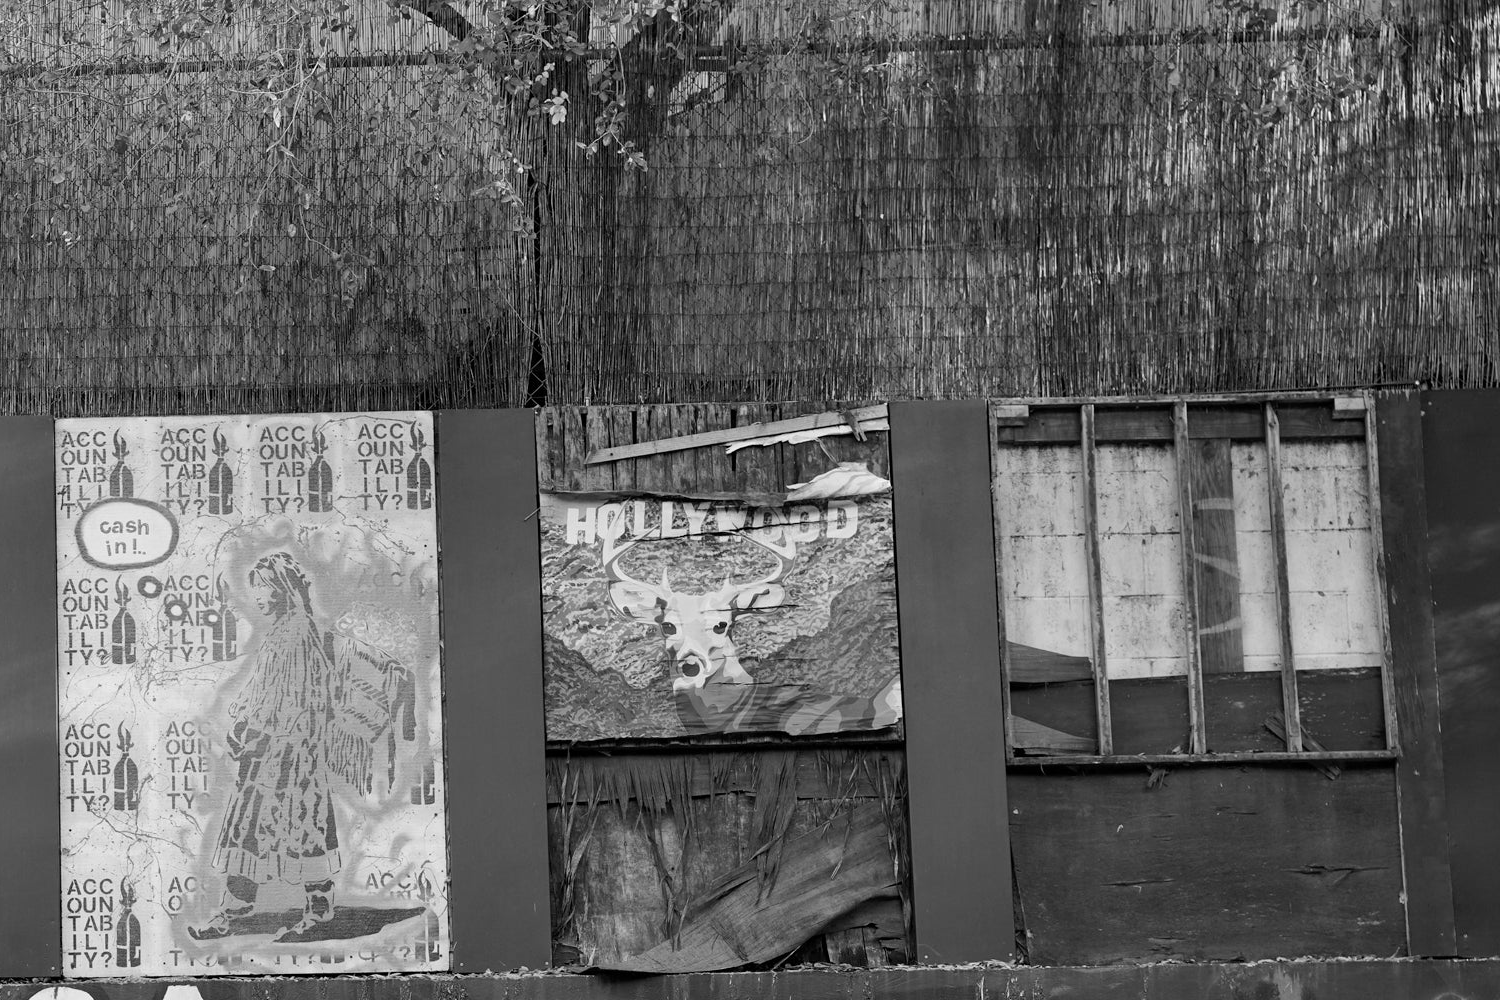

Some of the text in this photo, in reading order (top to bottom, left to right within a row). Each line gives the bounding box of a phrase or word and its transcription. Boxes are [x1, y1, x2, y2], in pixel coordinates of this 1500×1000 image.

[61, 431, 107, 448] ACC
[160, 428, 206, 444] ACC
[259, 426, 306, 442] ACC
[357, 424, 404, 440] ACC
[160, 446, 206, 463] OUN
[259, 444, 306, 460] OUN
[357, 441, 404, 457] OUN
[61, 449, 107, 466] OUN
[160, 463, 206, 480] TAB
[260, 462, 306, 478] TAB
[358, 458, 404, 475] TAB
[62, 467, 107, 483] TAB
[165, 481, 203, 498] ILI
[264, 479, 302, 496] ILI
[363, 477, 400, 492] ILI
[260, 497, 305, 514] TY?
[360, 494, 403, 511] TY?
[100, 519, 150, 535] cash
[566, 499, 859, 545] HOLLYWOOD
[62, 578, 108, 594] ACC
[163, 575, 210, 591] ACC
[62, 596, 109, 612] OUN
[63, 614, 109, 629] TAB
[67, 631, 105, 648] ILI
[168, 629, 206, 644] ILI
[64, 649, 109, 666] TY?
[164, 645, 208, 663] TY?
[65, 724, 111, 740] ACC
[65, 741, 111, 758] OUN
[65, 759, 111, 776] TAB
[70, 777, 108, 793] ILI
[171, 775, 208, 791] ILI
[66, 795, 111, 813] TY?
[67, 879, 113, 895] ACC
[67, 896, 113, 913] OUN
[68, 915, 113, 931] TAB
[72, 933, 110, 950] ILI
[67, 951, 113, 969] TY?
